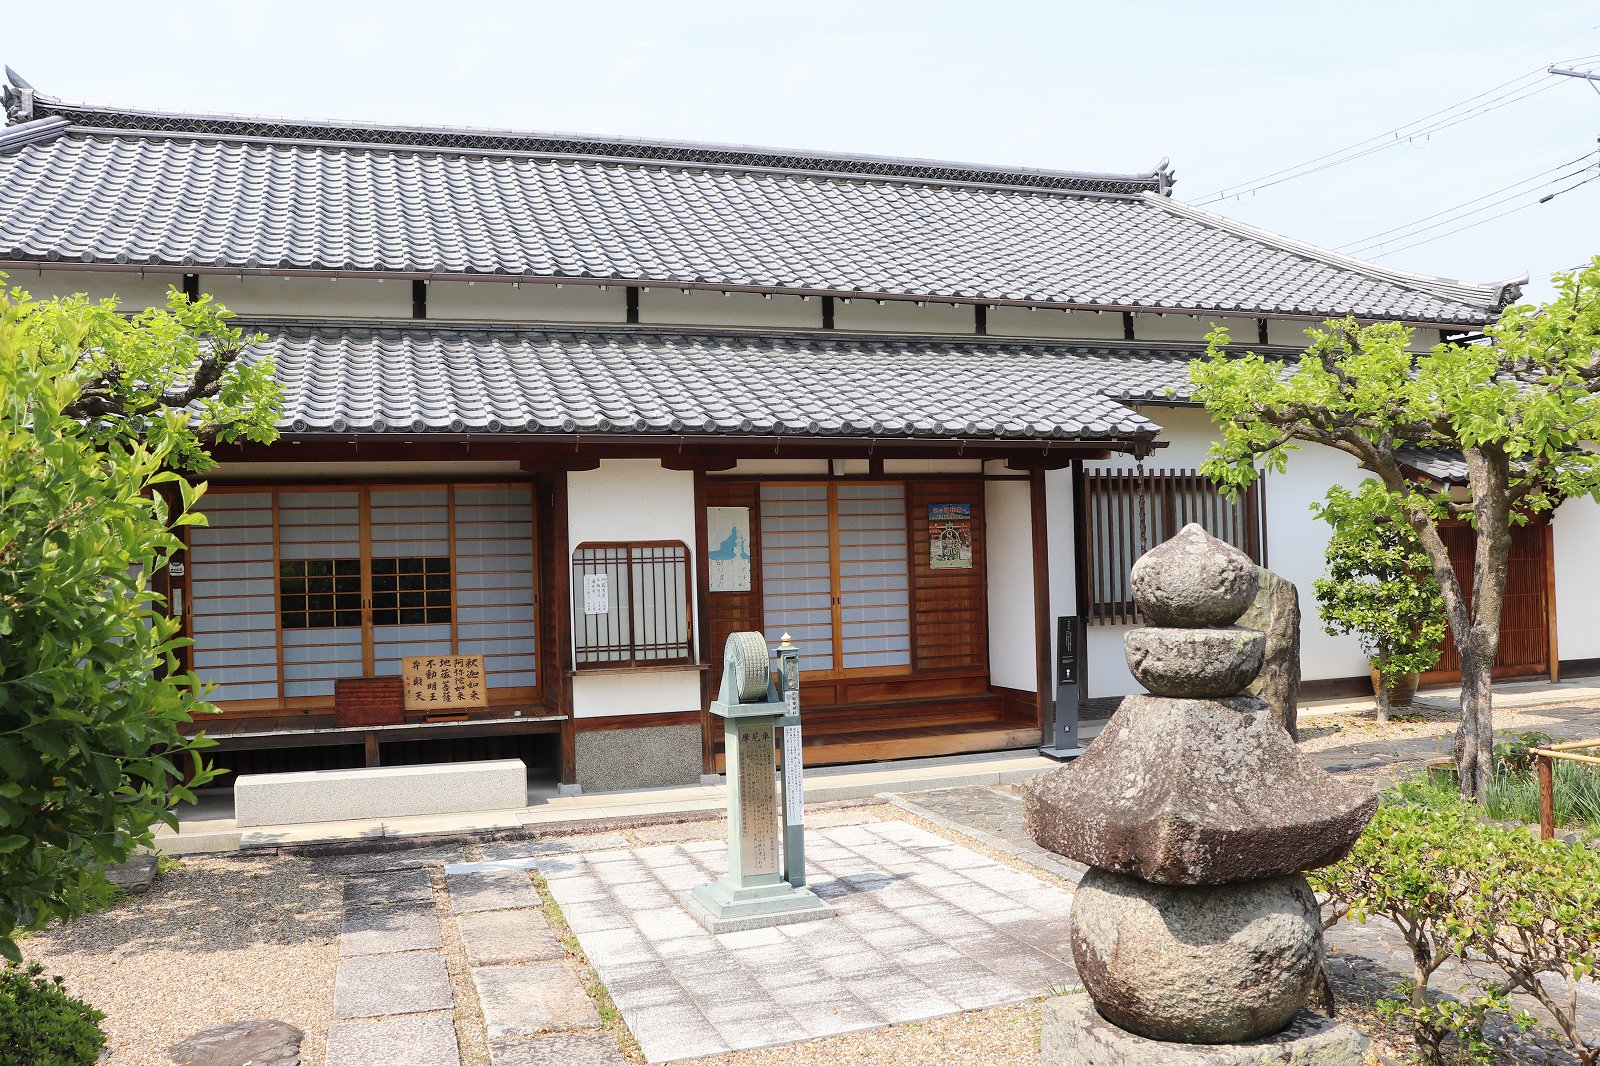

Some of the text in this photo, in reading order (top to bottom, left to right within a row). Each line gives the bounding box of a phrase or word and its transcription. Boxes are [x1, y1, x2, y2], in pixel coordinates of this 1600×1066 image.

[425, 659, 438, 701] 不動明王
[741, 731, 771, 743] 摩尼車
